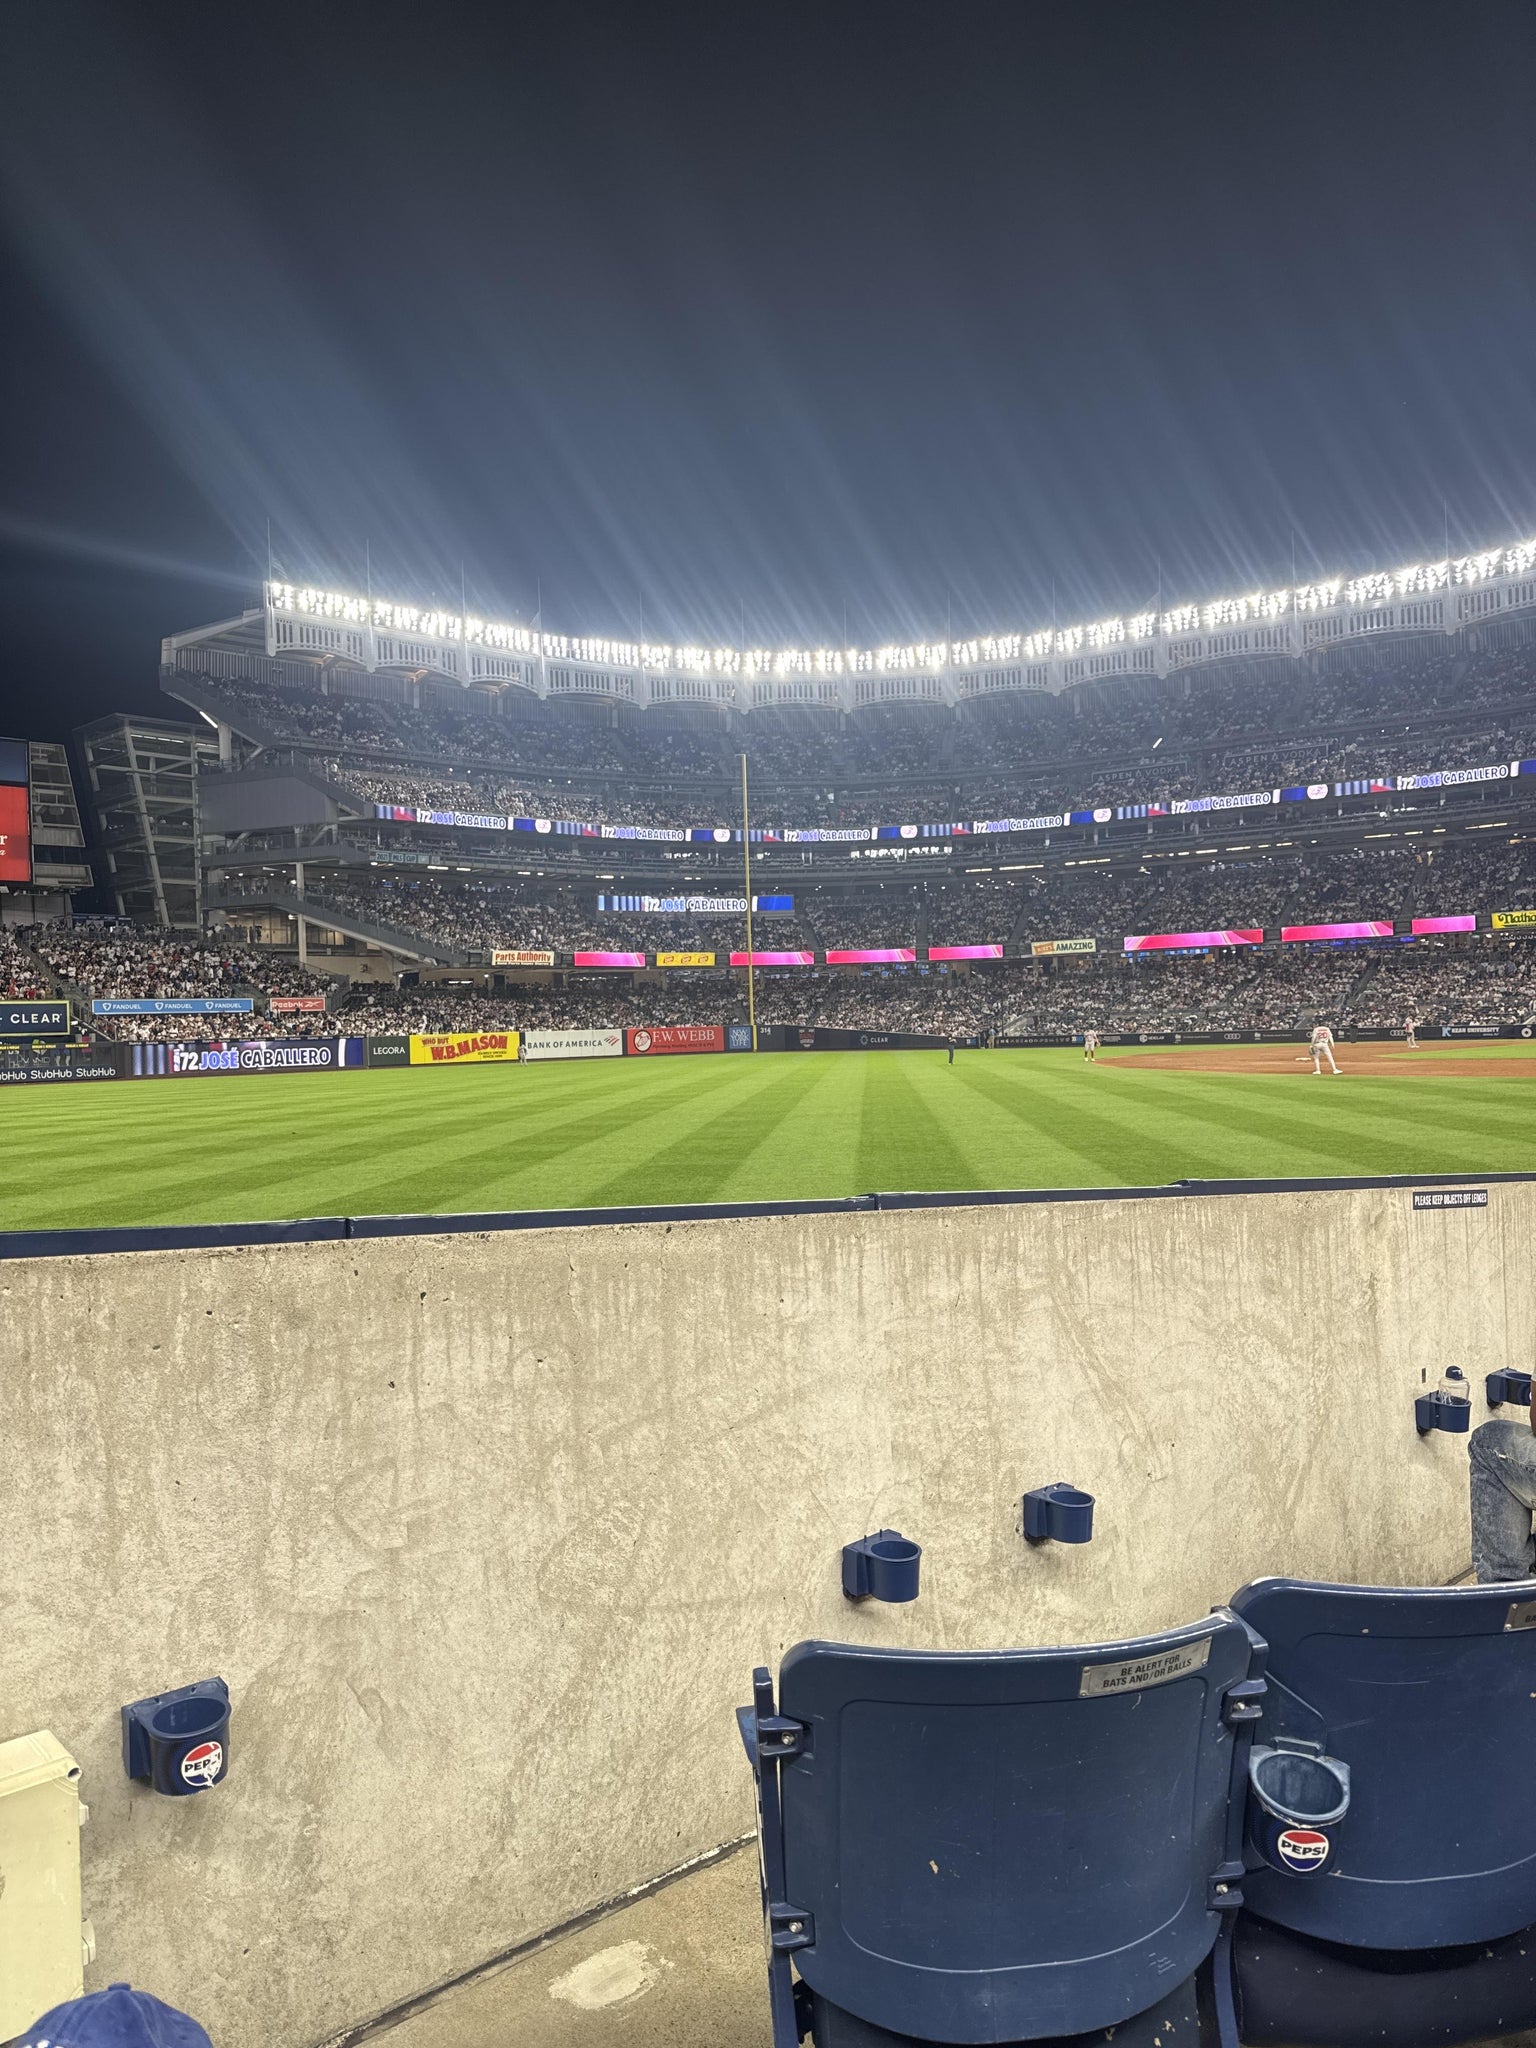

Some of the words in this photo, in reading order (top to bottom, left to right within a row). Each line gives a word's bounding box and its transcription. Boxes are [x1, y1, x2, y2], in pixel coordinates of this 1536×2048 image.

[1229, 754, 1267, 766] ASPEN
[1282, 748, 1323, 760] VODKA
[1097, 771, 1132, 783] ASPEN
[1145, 765, 1180, 777] VODKA
[1402, 776, 1414, 790] 72
[1441, 764, 1509, 785] CABALLERO
[1175, 801, 1186, 814] 72
[1210, 792, 1271, 809] CABALLERO
[420, 810, 432, 823] 72
[455, 811, 507, 830] CABALLERO
[976, 821, 987, 834] 72
[1009, 815, 1063, 831] CABALLERO
[604, 826, 615, 838] 72
[635, 827, 685, 842] CABALLERO
[787, 830, 799, 842] 72
[819, 829, 871, 842] CABALLERO
[650, 897, 660, 912] 72
[686, 898, 748, 912] CABALLERO
[1056, 941, 1094, 952] AMAZING
[495, 953, 516, 961] Parts
[517, 951, 551, 962] Authority
[10, 1013, 60, 1024] CLEAR
[652, 1030, 674, 1042] F.W.
[678, 1029, 715, 1041] WEBB
[373, 1046, 406, 1055] LEGORA
[527, 1041, 551, 1049] BANK
[565, 1039, 603, 1048] AMERICA
[180, 1051, 199, 1071] 72
[200, 1047, 240, 1070] JOSÉ
[240, 1046, 332, 1068] CABALLERO
[31, 1069, 73, 1080] StubHub
[76, 1068, 116, 1077] StubHub
[1414, 1195, 1432, 1206] PLEASE
[1432, 1194, 1443, 1205] KEEP
[1443, 1193, 1463, 1205] OBJECTS
[1463, 1193, 1472, 1204] OFF
[1471, 1192, 1487, 1204] LEDGES
[1121, 1667, 1133, 1677] BE
[1134, 1659, 1163, 1674] ALERT
[1164, 1653, 1180, 1666] FOR
[1103, 1675, 1128, 1688] BATS
[1129, 1665, 1166, 1684] AND/OR
[1167, 1658, 1192, 1674] BALLS
[1281, 1839, 1327, 1856] PEPSI
